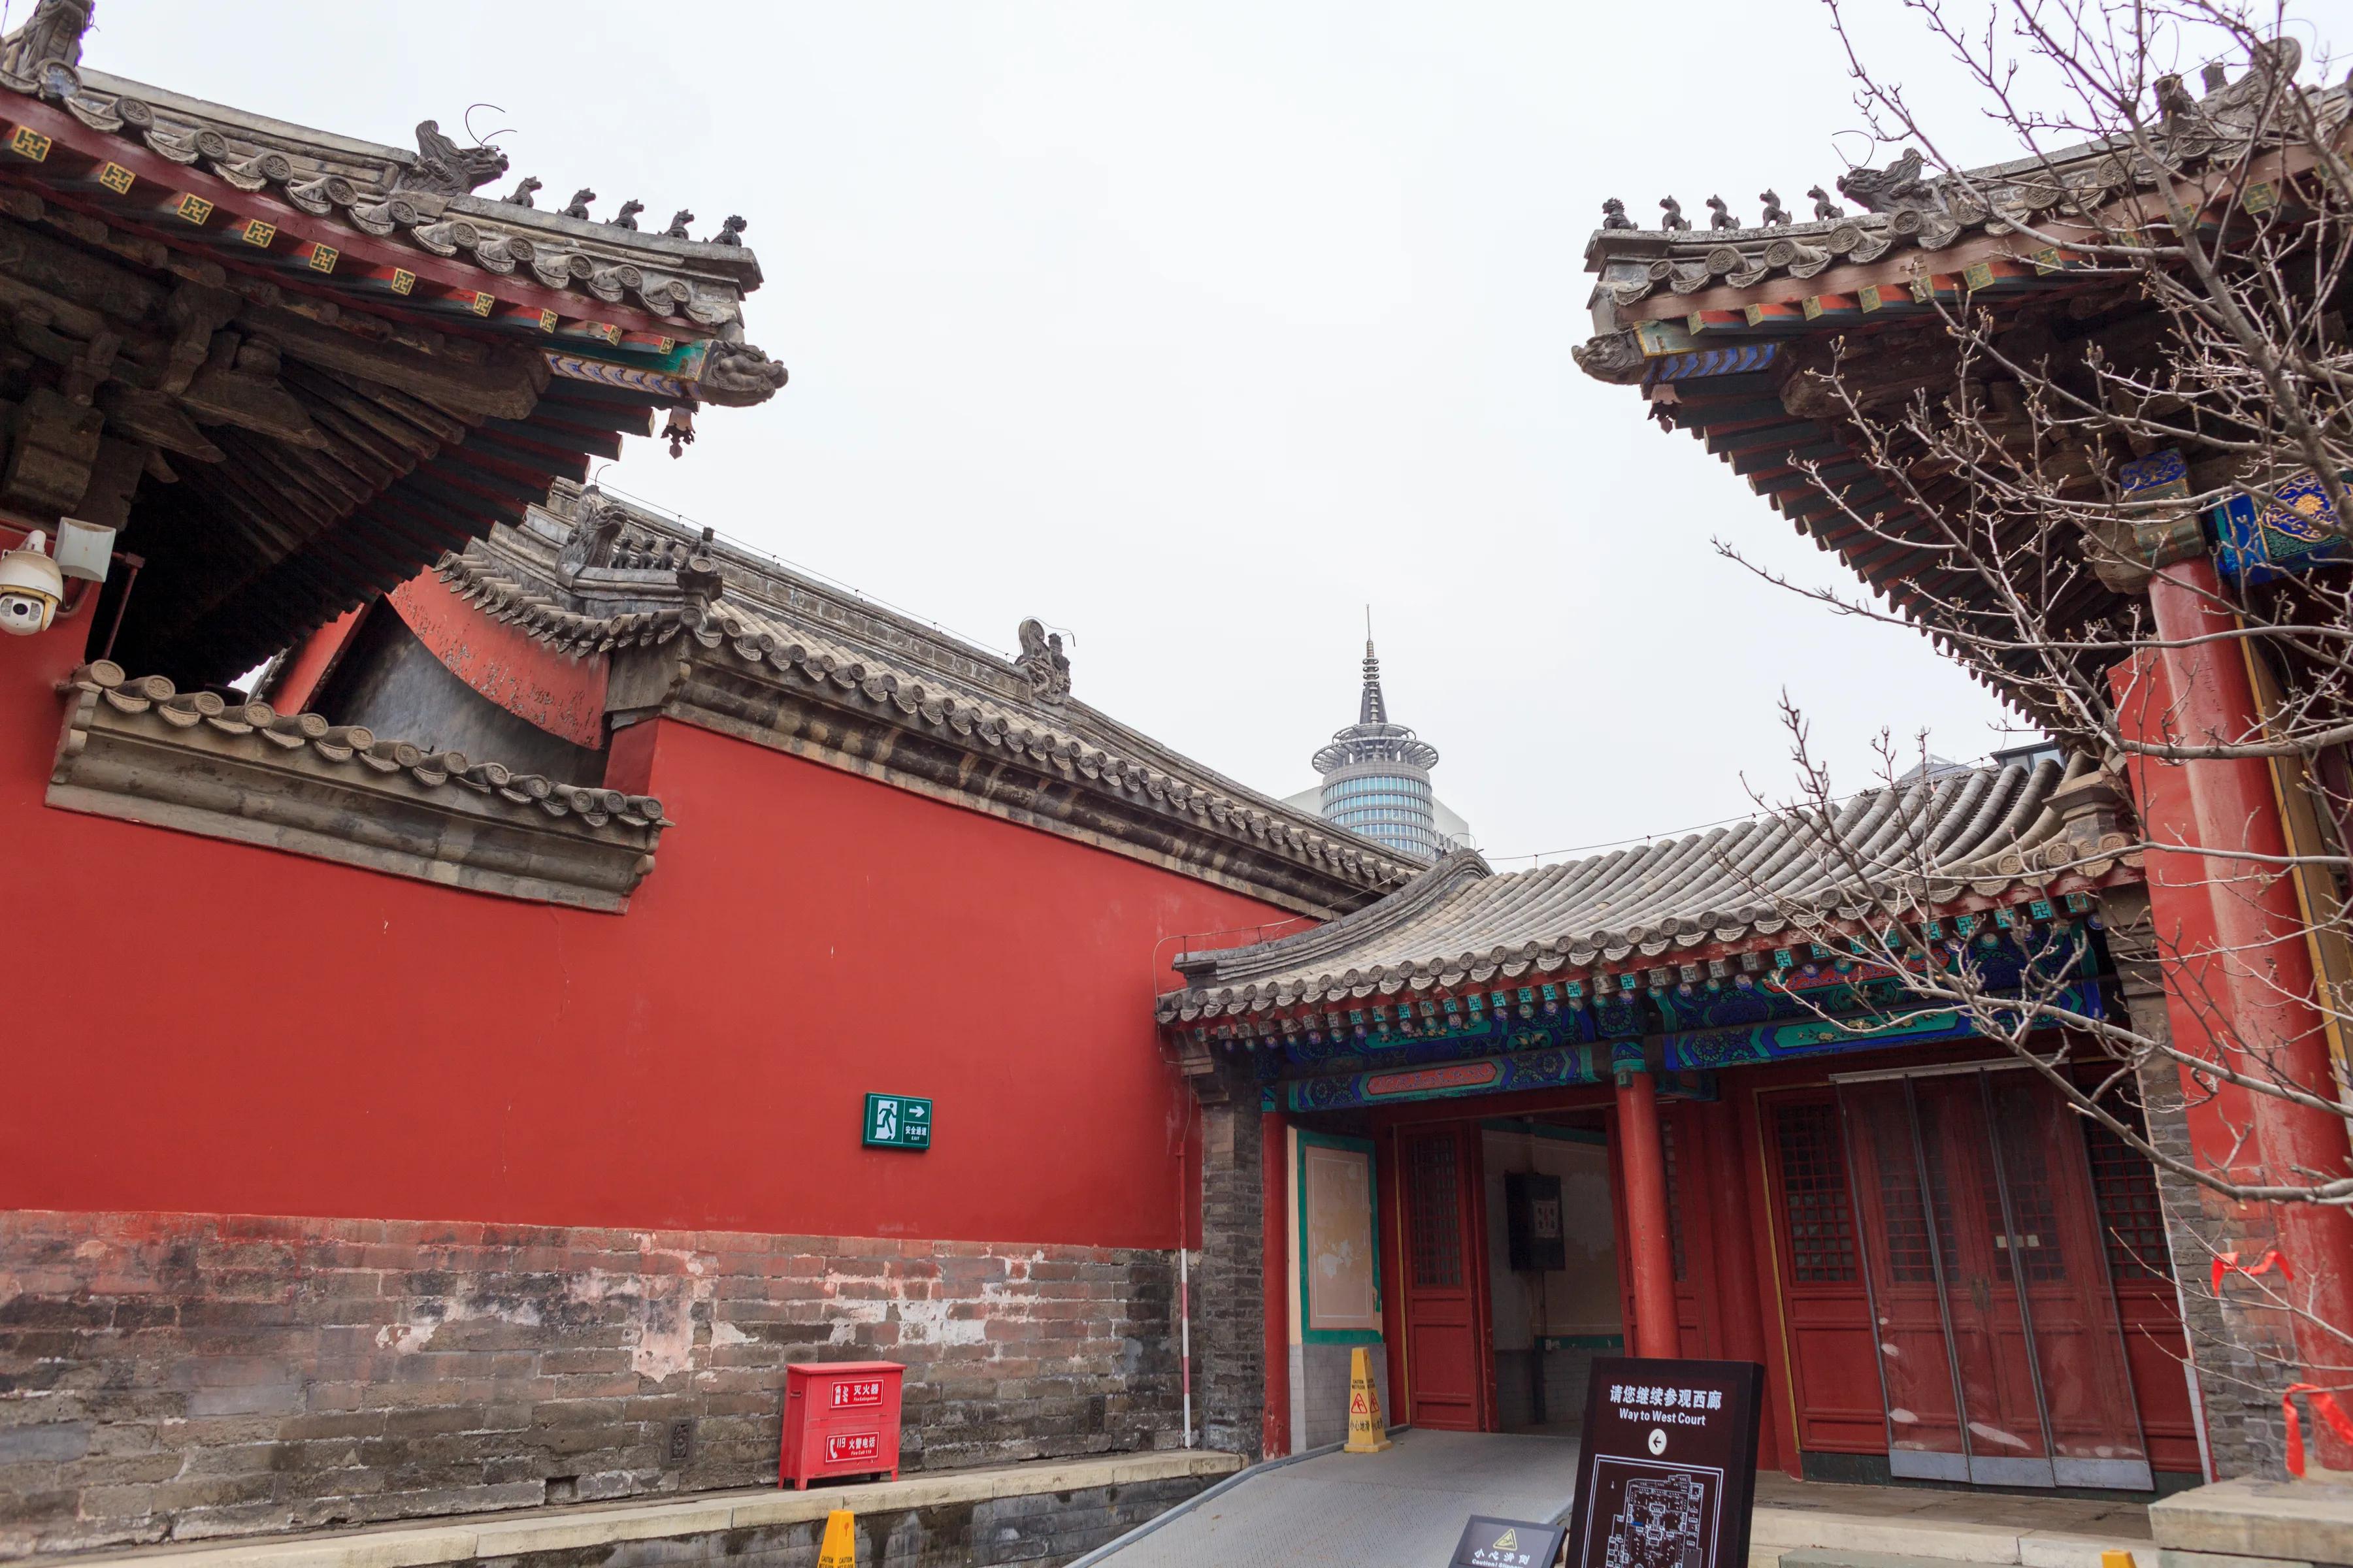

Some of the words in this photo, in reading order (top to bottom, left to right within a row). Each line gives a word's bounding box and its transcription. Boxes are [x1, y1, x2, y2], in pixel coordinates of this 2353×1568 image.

[906, 1125, 927, 1135] 安全通道
[853, 1383, 879, 1396] 灭火器
[1609, 1384, 1722, 1411] 请您继续参观西廊
[1619, 1407, 1639, 1422] Way
[1640, 1411, 1650, 1421] to
[1652, 1410, 1675, 1424] West
[1678, 1412, 1706, 1426] Court
[1350, 1420, 1370, 1431] 小心地滑
[837, 1437, 846, 1448] 119
[848, 1437, 876, 1450] 火警电话
[1472, 1558, 1498, 1567] Caution!
[1474, 1548, 1530, 1565] 小心滑倒
